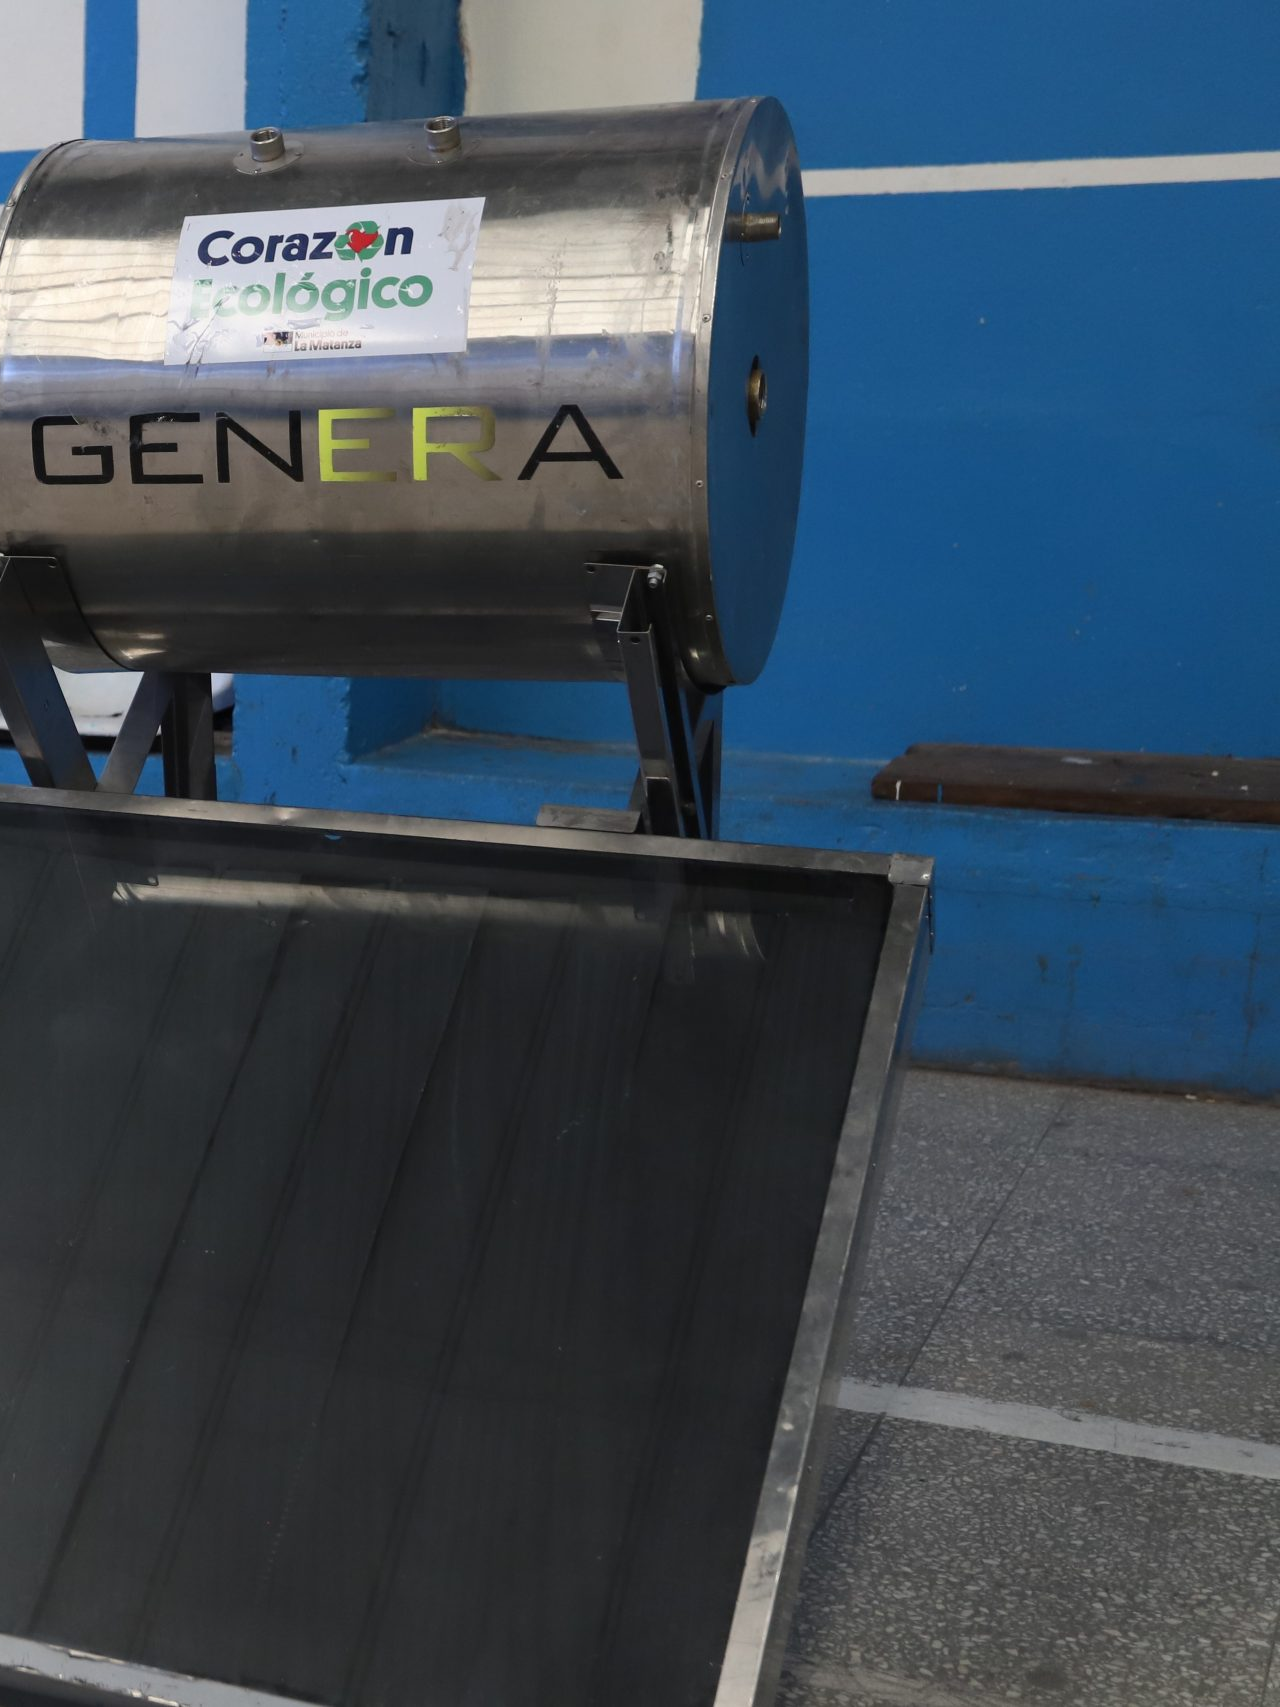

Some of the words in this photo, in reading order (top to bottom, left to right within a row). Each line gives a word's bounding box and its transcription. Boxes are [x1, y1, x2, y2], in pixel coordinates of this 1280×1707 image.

[190, 267, 433, 322] Ecológico
[294, 340, 307, 351] La
[309, 339, 362, 351] Matanza
[31, 404, 624, 485] GENERA
